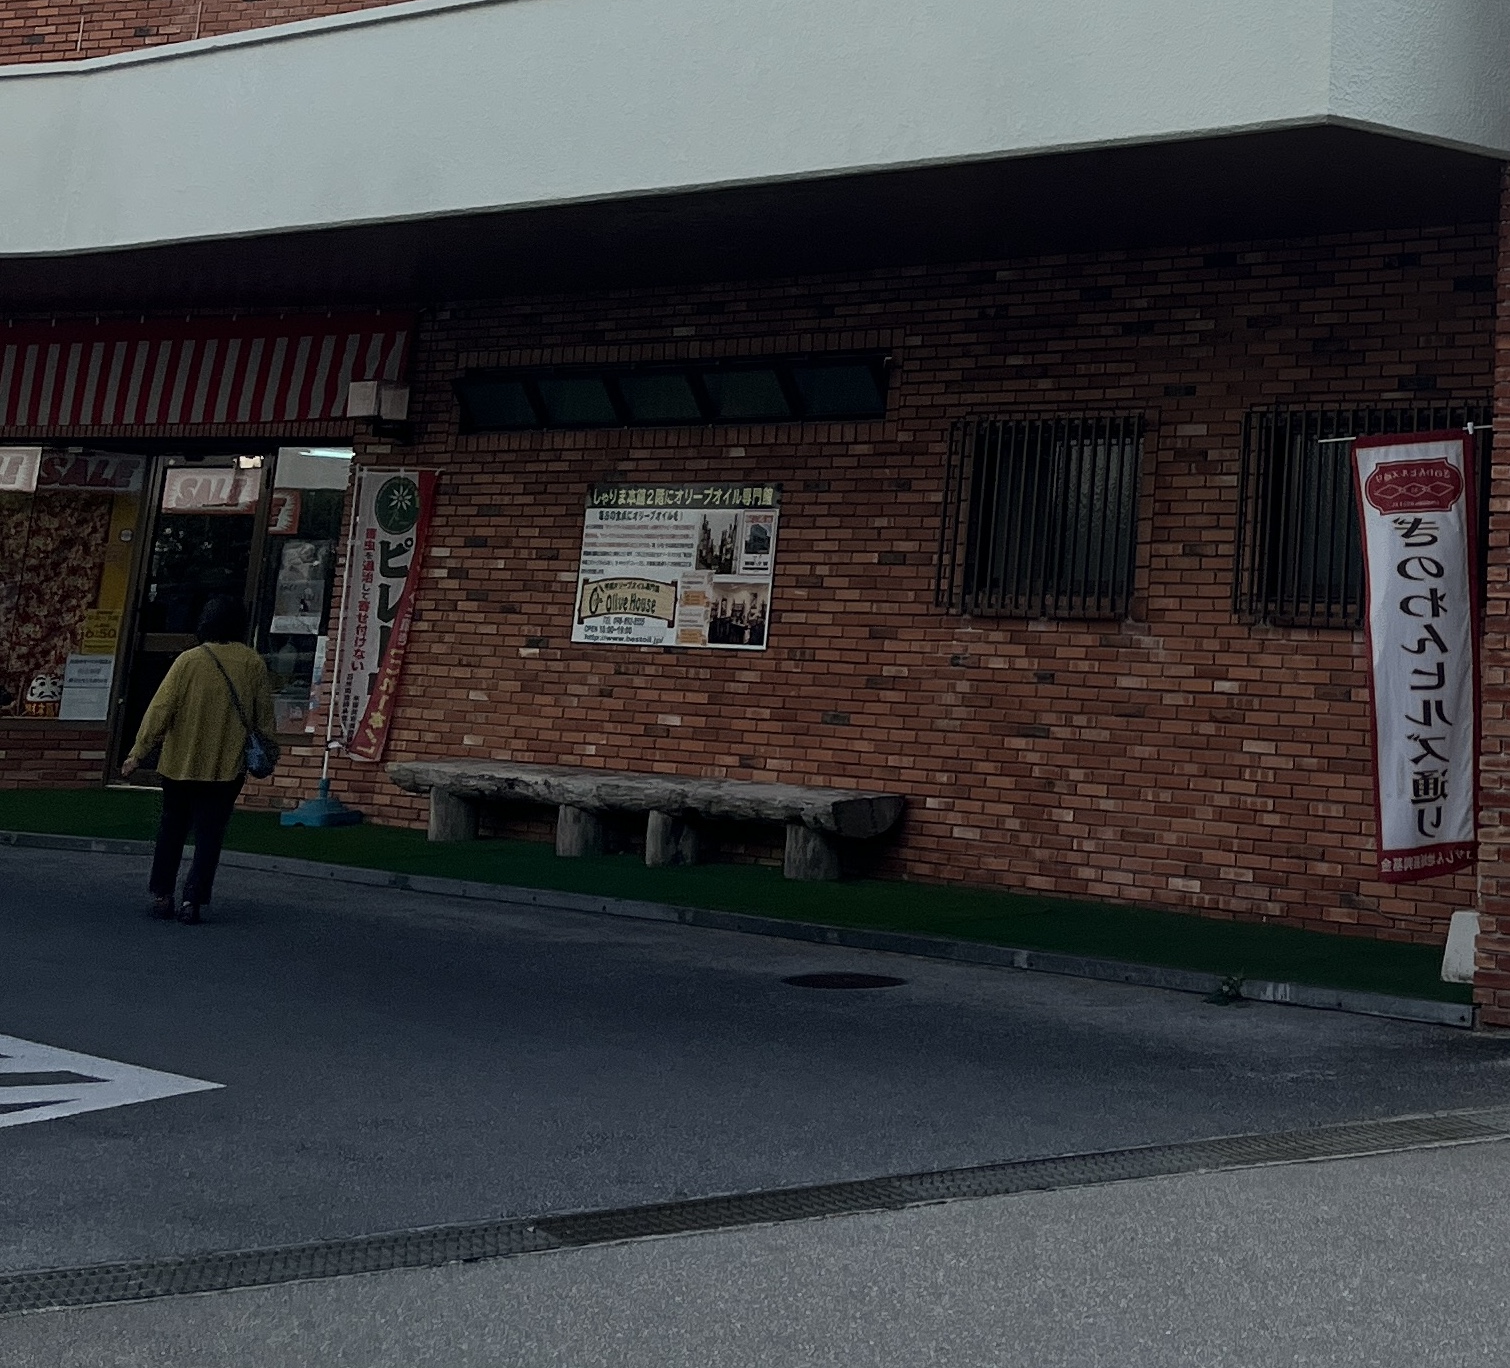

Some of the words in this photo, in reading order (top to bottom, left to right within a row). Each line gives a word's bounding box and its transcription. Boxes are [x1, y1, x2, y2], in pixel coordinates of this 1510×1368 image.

[39, 457, 141, 487] SALE
[605, 593, 628, 612] Olive
[629, 593, 657, 615] House
